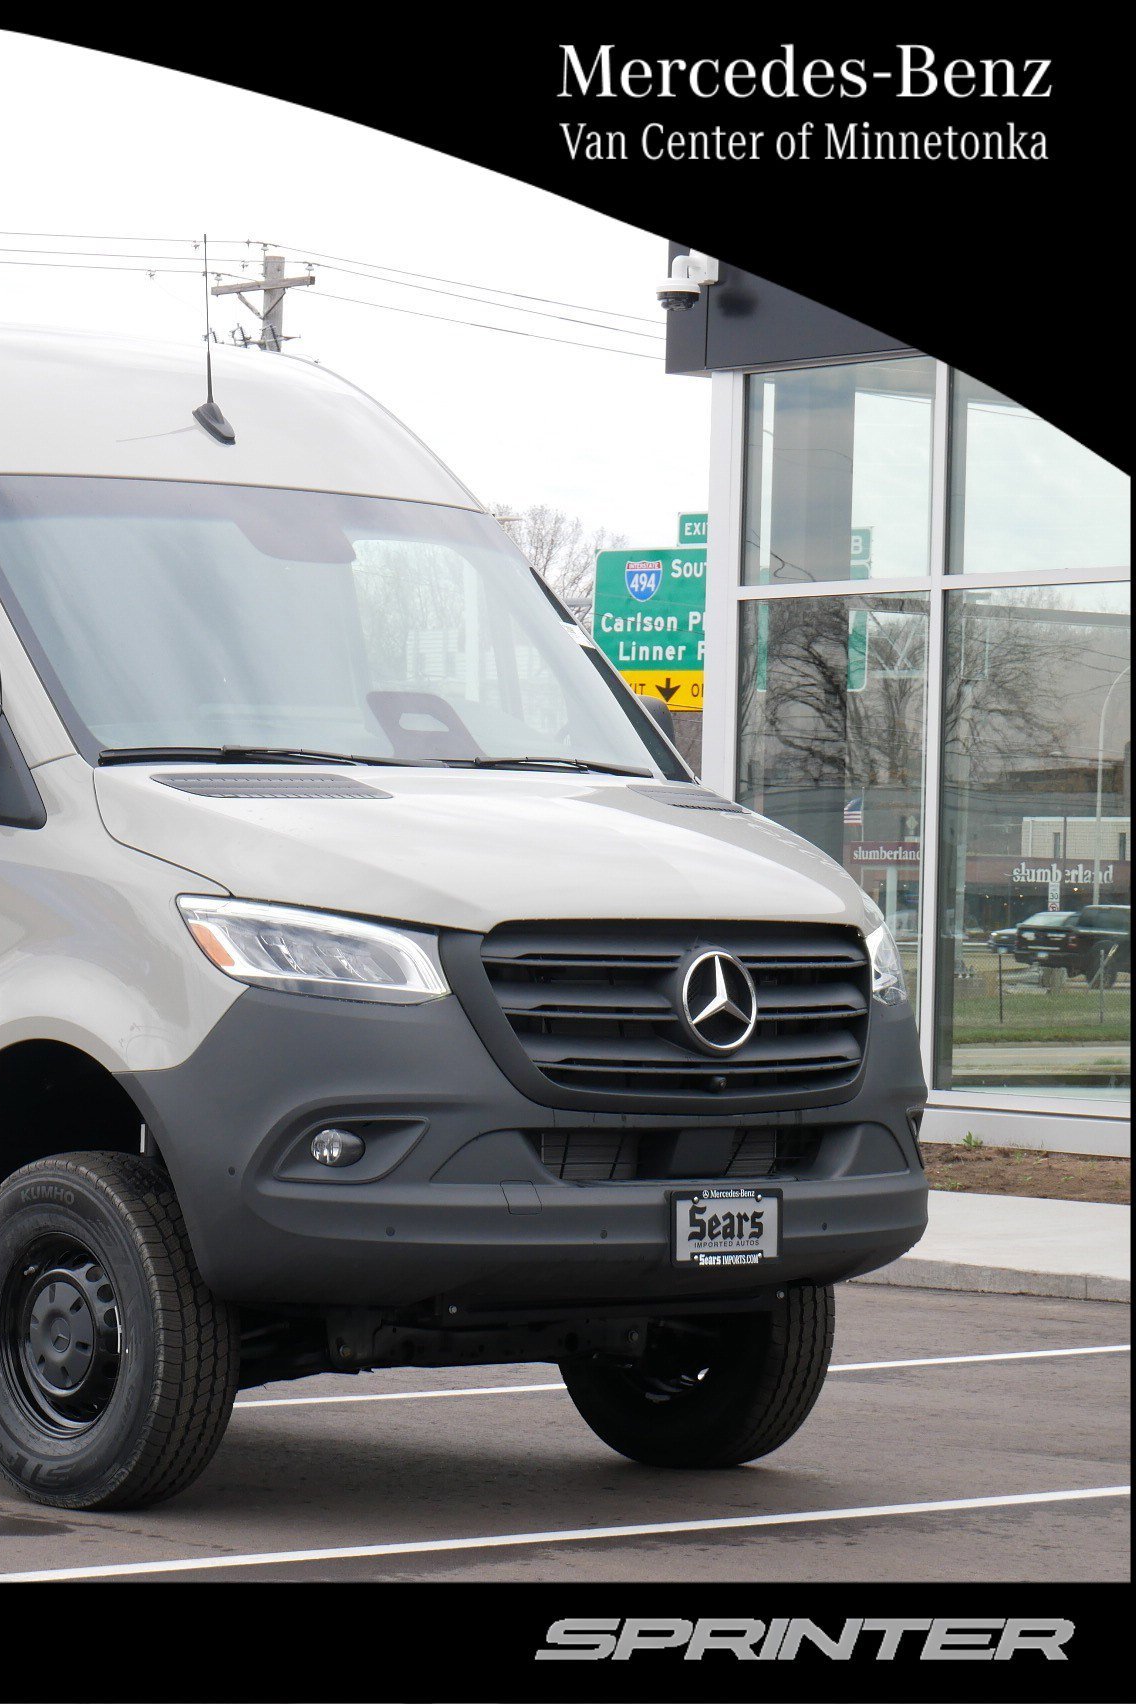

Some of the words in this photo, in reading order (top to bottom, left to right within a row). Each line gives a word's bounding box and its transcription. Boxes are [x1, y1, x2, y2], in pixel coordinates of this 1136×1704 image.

[684, 522, 708, 536] EXI
[670, 558, 707, 578] SOU
[630, 572, 656, 592] 494
[601, 612, 678, 632] Carlson
[618, 641, 687, 660] Linner
[21, 1186, 75, 1205] KUMHO
[710, 1189, 755, 1199] Mercedes-Benz
[688, 1204, 764, 1241] Sears
[694, 1240, 734, 1248] IMPORTED
[736, 1239, 760, 1247] AUTOS
[699, 1253, 721, 1265] Sears
